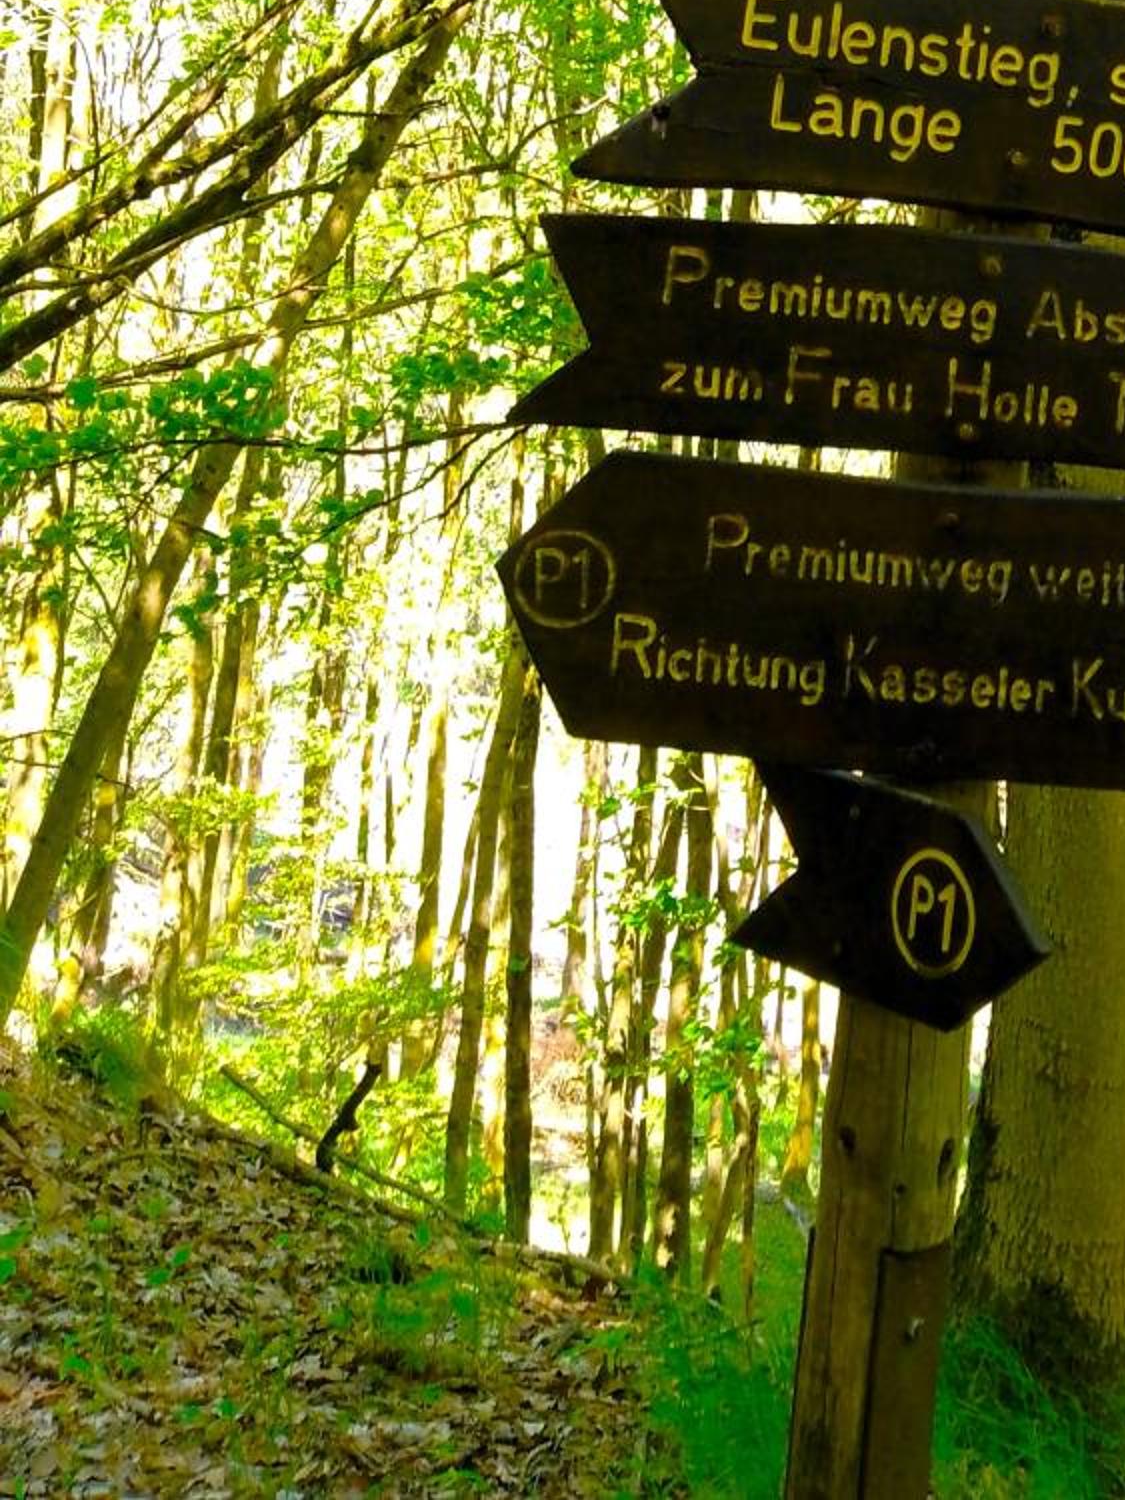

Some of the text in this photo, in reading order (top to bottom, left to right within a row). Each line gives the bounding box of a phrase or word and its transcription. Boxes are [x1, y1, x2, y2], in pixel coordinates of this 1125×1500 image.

[661, 245, 998, 345] Premiumweg
[659, 360, 763, 401] zum
[784, 345, 914, 412] Frau
[946, 356, 1078, 429] Holle
[532, 546, 591, 610] P1
[705, 512, 1012, 602] Premiumweg
[609, 612, 826, 706] Richtung
[844, 634, 1056, 712] Kasseler
[907, 874, 956, 952] P1
